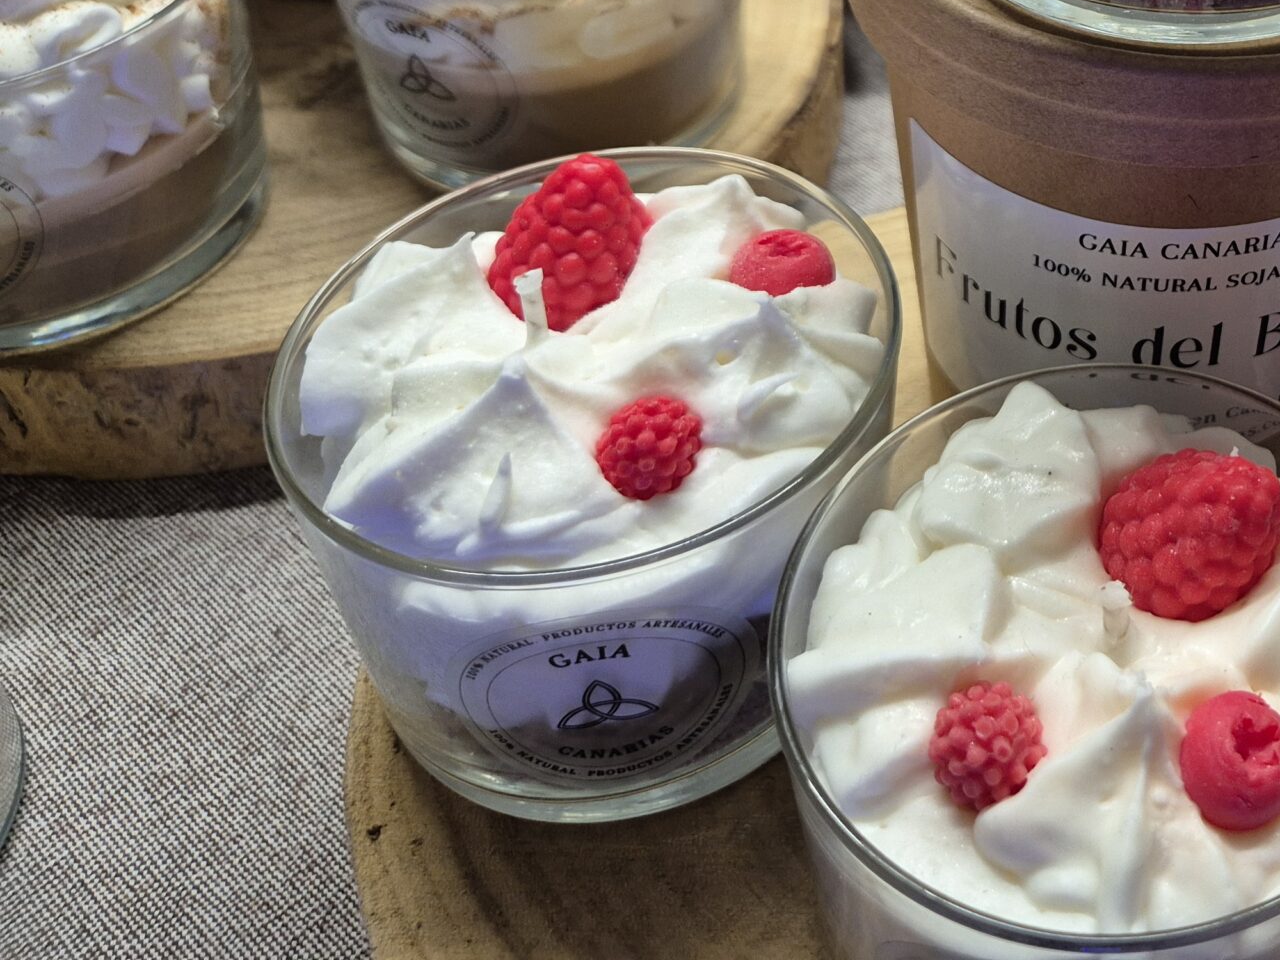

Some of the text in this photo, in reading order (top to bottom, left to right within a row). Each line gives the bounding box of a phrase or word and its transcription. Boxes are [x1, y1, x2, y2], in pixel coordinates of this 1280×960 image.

[1078, 233, 1150, 259] GAIA
[1032, 253, 1092, 283] 100%
[1101, 272, 1218, 292] NATURAL
[935, 233, 1098, 361] Frutos
[1131, 321, 1224, 369] del
[541, 620, 637, 642] PRODUCTOS
[642, 620, 726, 638] ARTESANALES
[548, 643, 631, 669] GAIA
[557, 725, 675, 760] CANARIAS
